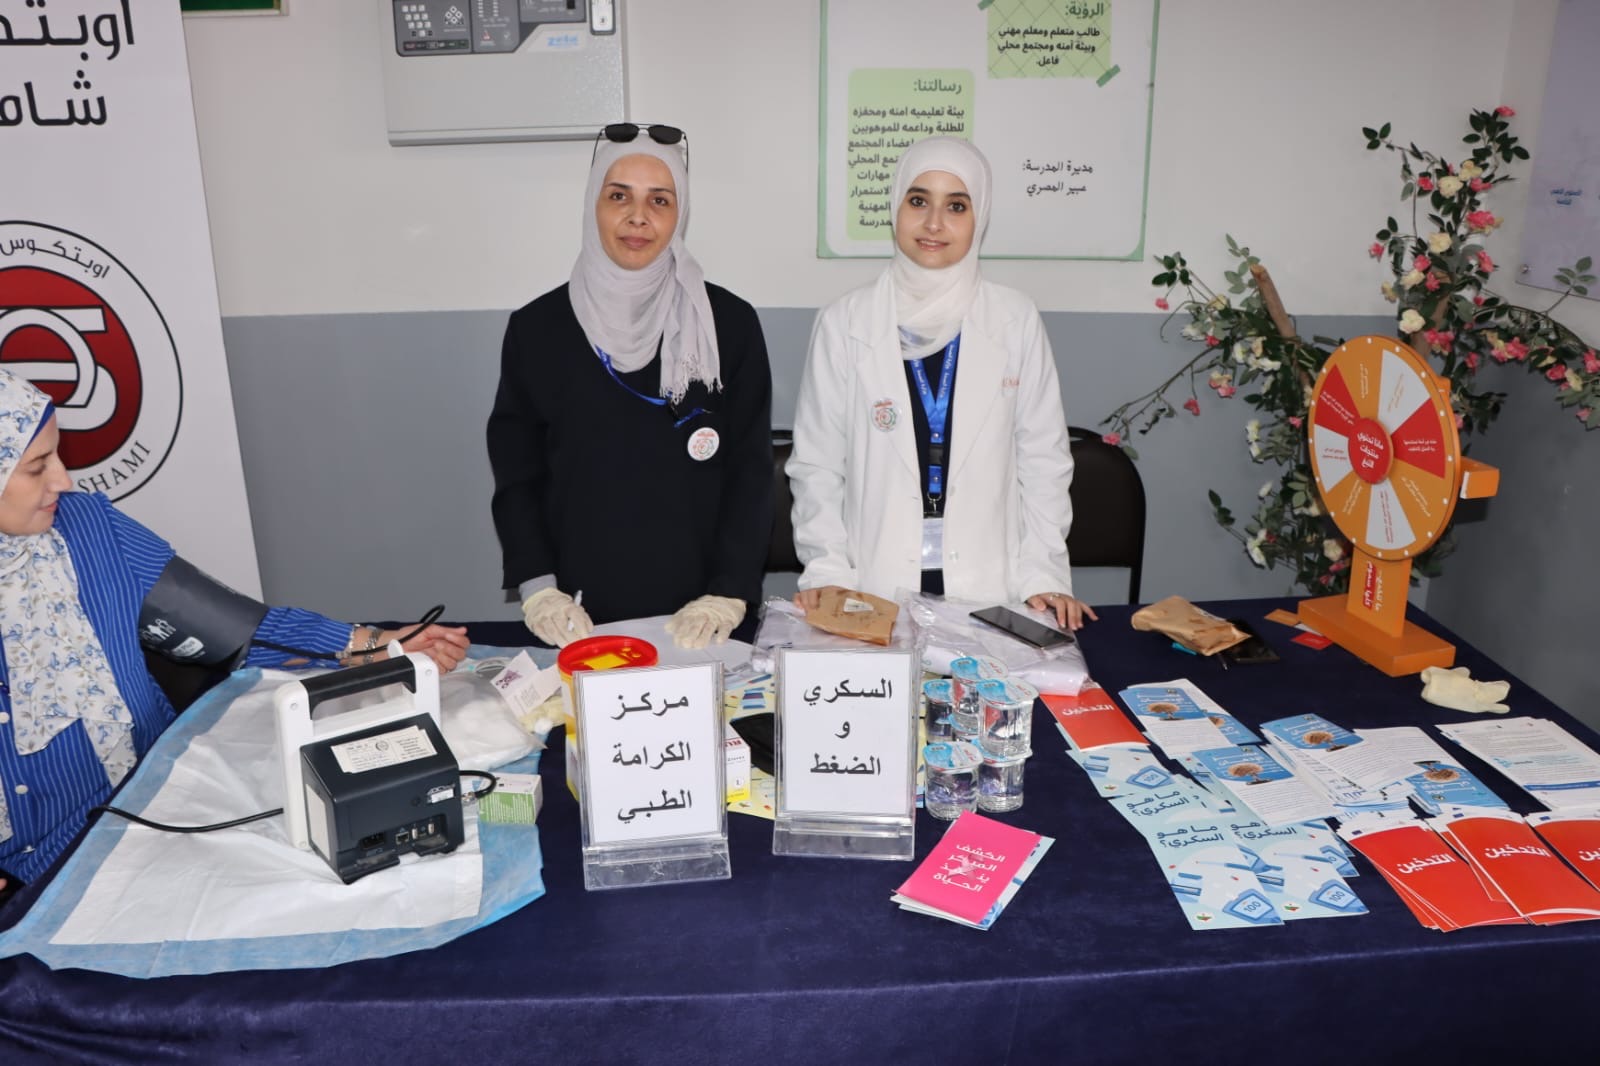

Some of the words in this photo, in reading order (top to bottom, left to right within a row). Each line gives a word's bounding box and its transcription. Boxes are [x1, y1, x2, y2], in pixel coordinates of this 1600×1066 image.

[1065, 1, 1104, 19] الرؤية:
[998, 27, 1021, 38] مهني
[1022, 26, 1048, 38] ومعلم
[1050, 26, 1075, 38] متعلم
[1076, 26, 1101, 38] طالب
[997, 41, 1020, 53] محلي
[1022, 41, 1054, 53] ومجتمع
[1075, 41, 1096, 53] وبيئة
[914, 79, 962, 94] رسالتنا:
[911, 107, 945, 119] تعليميه
[947, 106, 965, 119] بيئة
[852, 122, 900, 134] للموهوبين
[902, 123, 934, 134] وداعمه
[936, 121, 965, 134] للطلبة
[847, 138, 885, 152] المجتمع
[848, 154, 880, 168] المحلي
[1022, 159, 1064, 175] المدرسة:
[1067, 160, 1093, 176] مديرة
[857, 170, 890, 181] مهارات
[1026, 181, 1064, 197] المصري
[1066, 185, 1087, 196] عبير
[77, 440, 151, 494] SHAMI
[803, 679, 892, 704] السكري
[611, 691, 689, 720] مركز
[835, 720, 851, 739] و
[612, 742, 691, 770] الكرامة
[810, 753, 881, 777] الضغط
[1154, 791, 1180, 800] ما
[617, 790, 693, 824] الطبي
[1127, 797, 1155, 809] هو
[1132, 797, 1189, 816] السكري؟
[1230, 822, 1261, 831] هو
[1157, 829, 1188, 839] هو
[1234, 827, 1297, 840] السكري؟
[1160, 833, 1224, 848] السكري؟
[956, 845, 1006, 862] الكشف
[1485, 844, 1551, 859] التدخين
[1397, 853, 1456, 874] التدخين
[933, 873, 983, 892] الحياة
[1329, 891, 1345, 903] 100
[1244, 900, 1261, 913] 100
